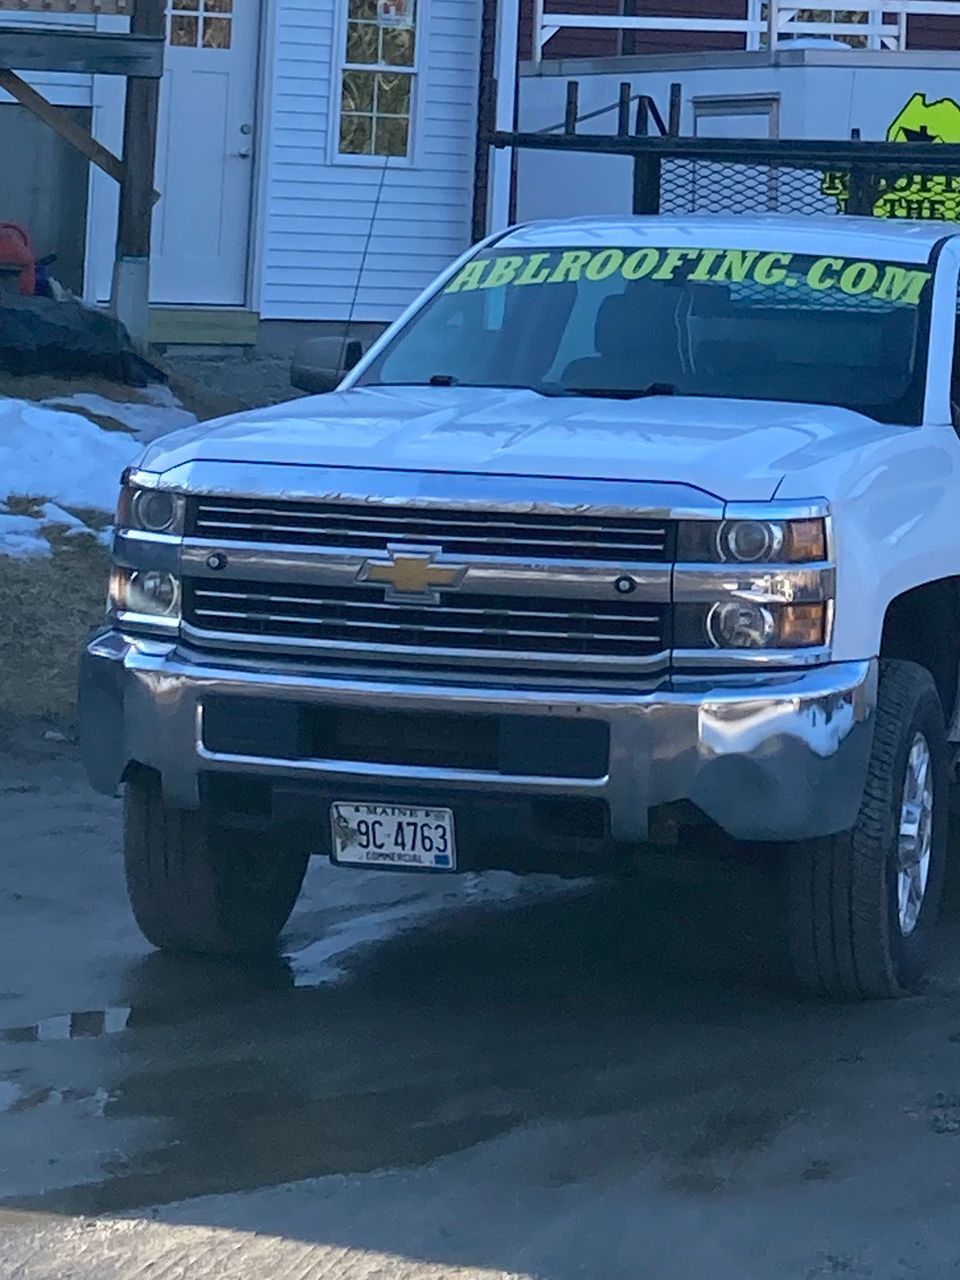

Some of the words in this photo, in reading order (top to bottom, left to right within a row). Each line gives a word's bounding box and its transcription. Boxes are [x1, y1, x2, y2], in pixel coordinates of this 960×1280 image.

[884, 198, 946, 220] THE
[443, 247, 931, 305] ABLROOFING.COM
[366, 806, 418, 818] MAINE
